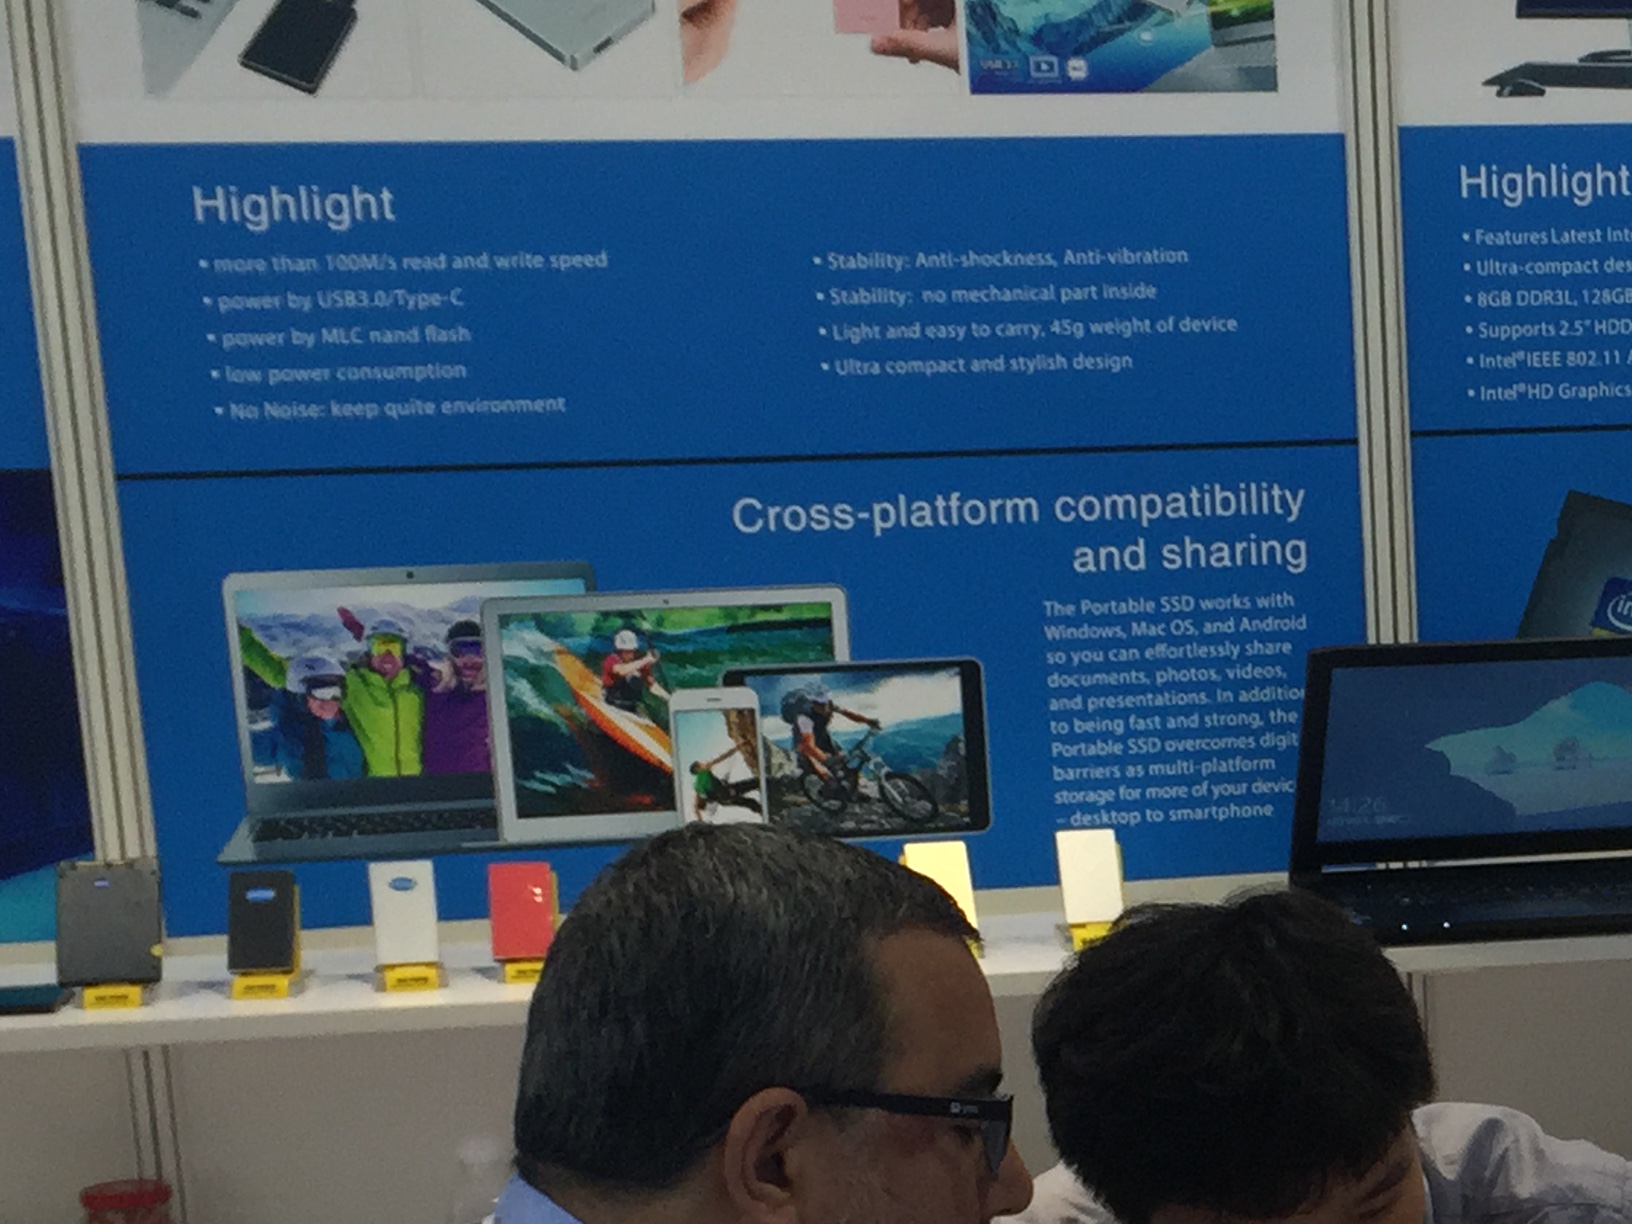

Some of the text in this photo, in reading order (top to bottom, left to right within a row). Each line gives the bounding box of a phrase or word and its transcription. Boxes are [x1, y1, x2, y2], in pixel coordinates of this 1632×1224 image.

[1461, 163, 1630, 207] Highlight
[193, 185, 395, 232] Highlight
[1476, 229, 1548, 245] Features
[1551, 228, 1602, 244] Latest
[1064, 247, 1188, 264] Anti-vibration
[1477, 258, 1598, 276] Ultra-compact
[922, 290, 947, 303] no
[952, 284, 1055, 303] mechanical
[1060, 285, 1098, 304] part
[1478, 290, 1511, 307] 8GB
[833, 323, 881, 344] Light
[886, 322, 921, 339] and
[925, 325, 966, 341] easy
[971, 322, 991, 337] to
[1050, 319, 1084, 339] 45g
[1089, 317, 1152, 338] weight
[1156, 316, 1174, 332] of
[1179, 316, 1237, 332] device
[1479, 322, 1555, 340] Supports
[835, 352, 1132, 376] Ultra compact and stylish design
[1566, 350, 1619, 366] 802.11
[1558, 381, 1632, 401] Graphics
[733, 483, 1304, 536] Cross-platform compatibility
[1073, 533, 1306, 573] and sharing
[1043, 592, 1294, 616] The Portable SSD works with
[1131, 621, 1166, 636] Mac
[1203, 617, 1235, 634] and
[1240, 614, 1307, 631] Android
[1070, 640, 1292, 666] you can effortlessly share
[1049, 694, 1083, 711] and
[1073, 708, 1298, 735] being fast and the
[1052, 736, 1256, 757] Portable SSD overcomes
[1053, 756, 1275, 781] barriers multi-platform
[1054, 783, 1248, 805] storage for more your
[1068, 803, 1273, 826] desktop smartphone
